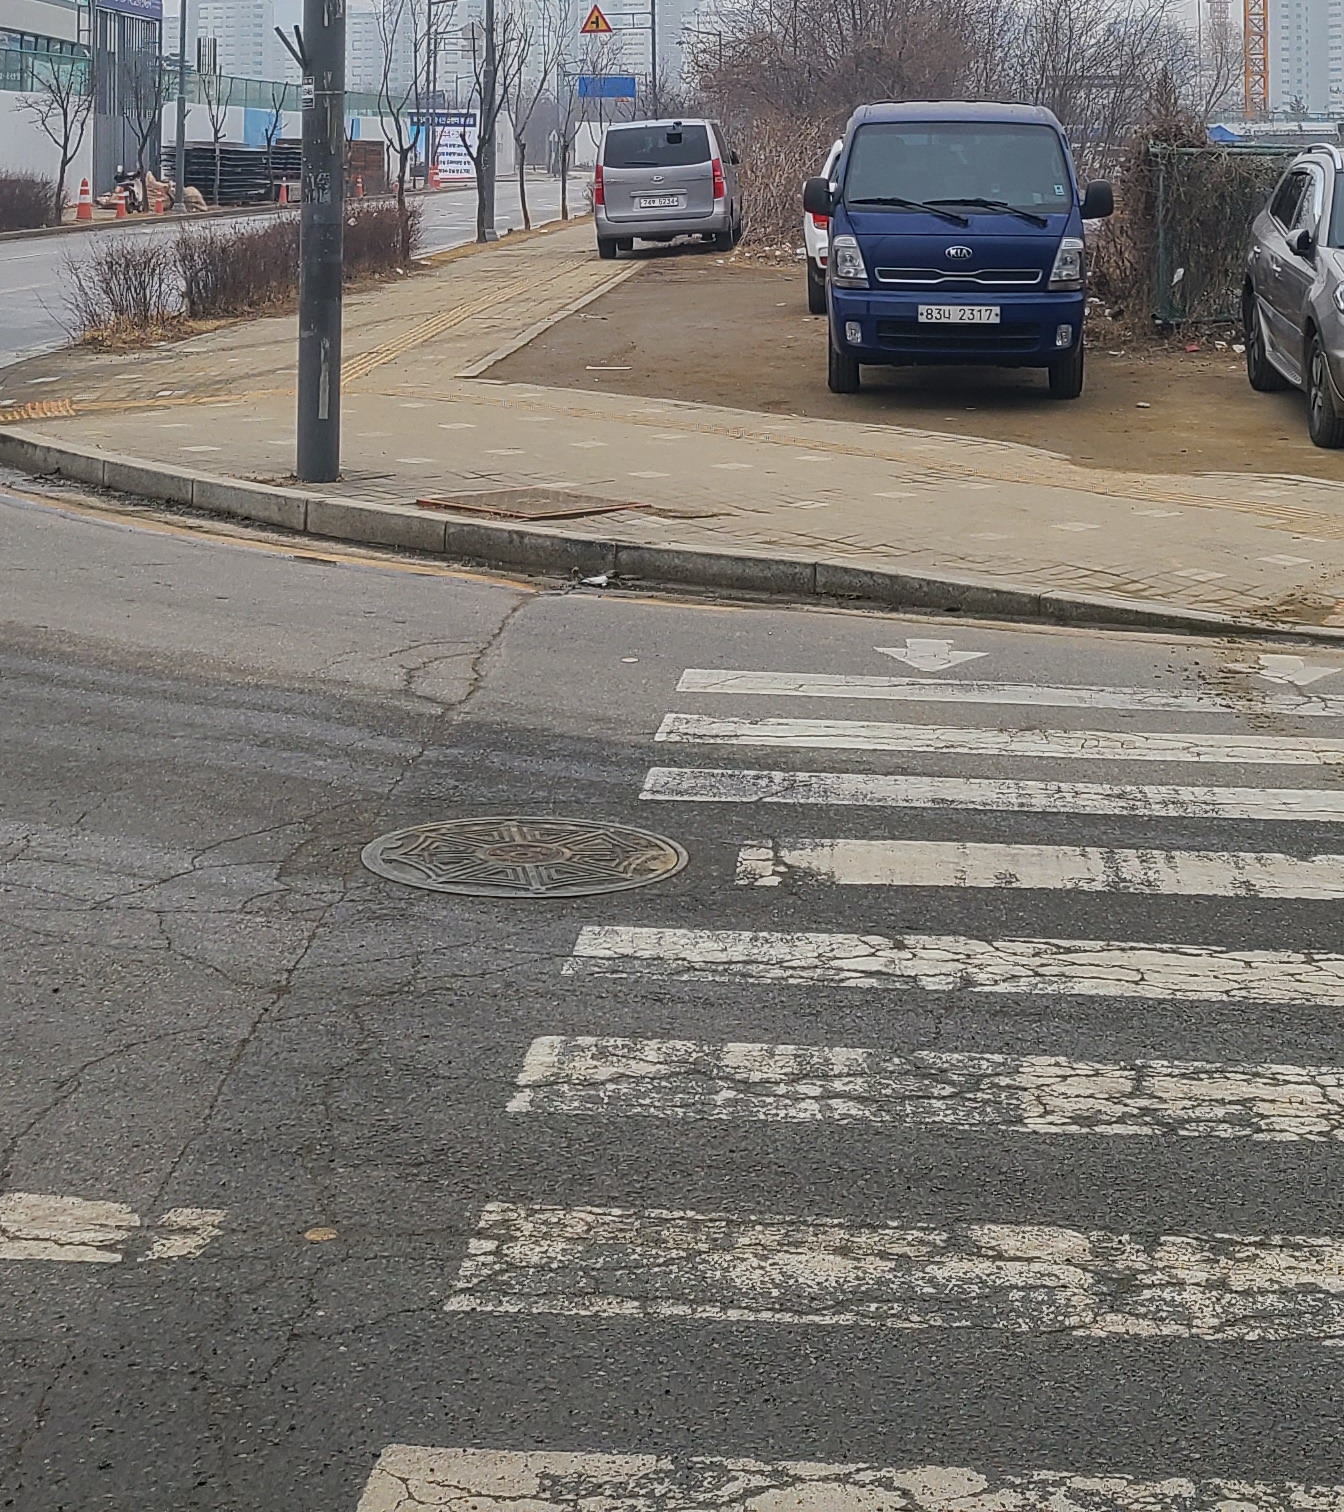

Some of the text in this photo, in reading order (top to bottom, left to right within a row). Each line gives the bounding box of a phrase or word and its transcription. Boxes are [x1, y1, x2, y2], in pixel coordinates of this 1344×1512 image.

[948, 248, 970, 258] KIA
[925, 308, 993, 321] 83나 2317
